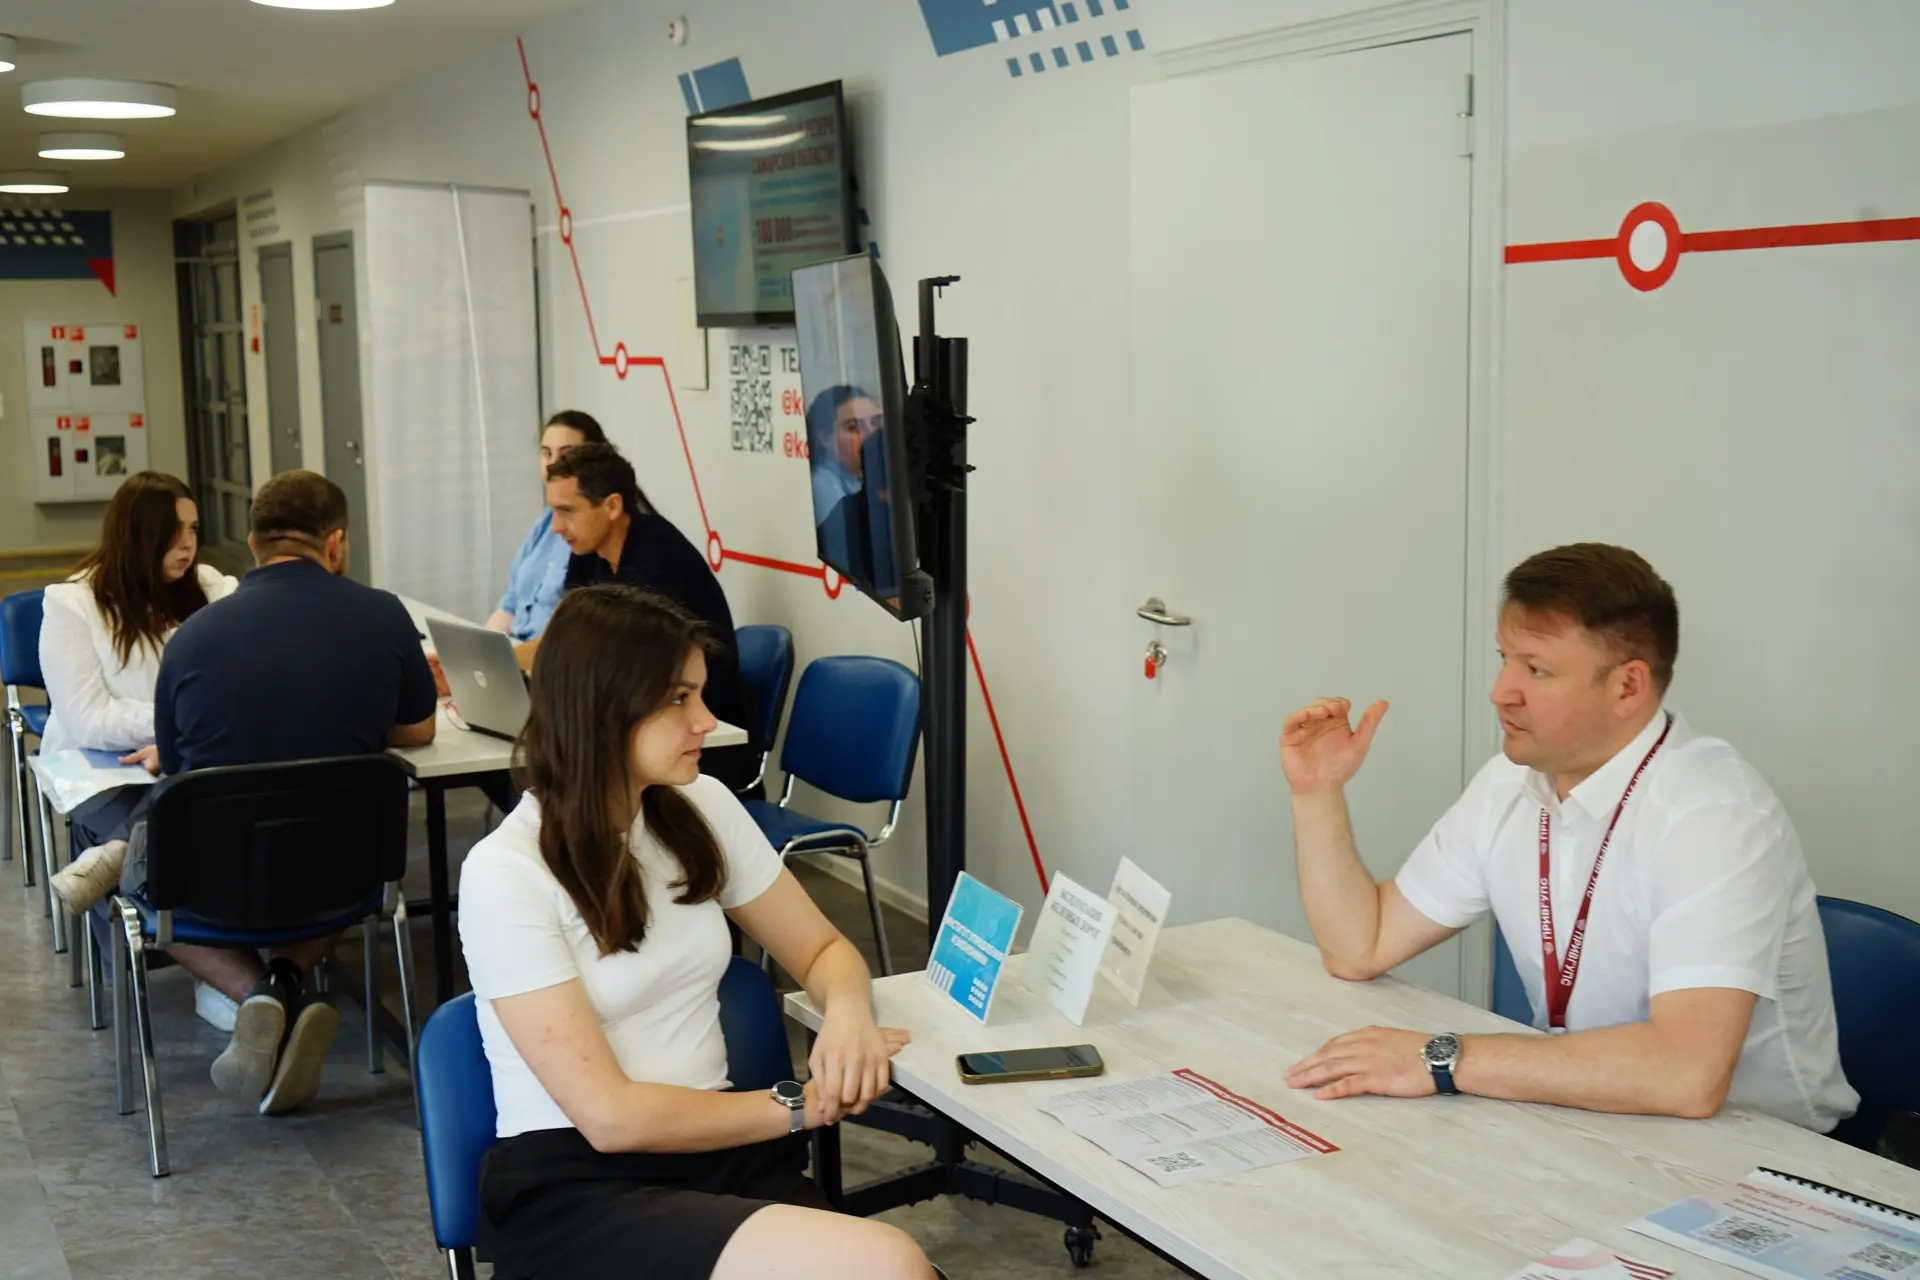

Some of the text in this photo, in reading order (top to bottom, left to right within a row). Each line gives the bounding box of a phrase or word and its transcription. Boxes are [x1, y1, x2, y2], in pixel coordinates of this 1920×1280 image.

[781, 348, 800, 373] ТЕ
[1540, 878, 1553, 940] ПРИВГУПС
[1560, 930, 1584, 986] ПРИВГУПС
